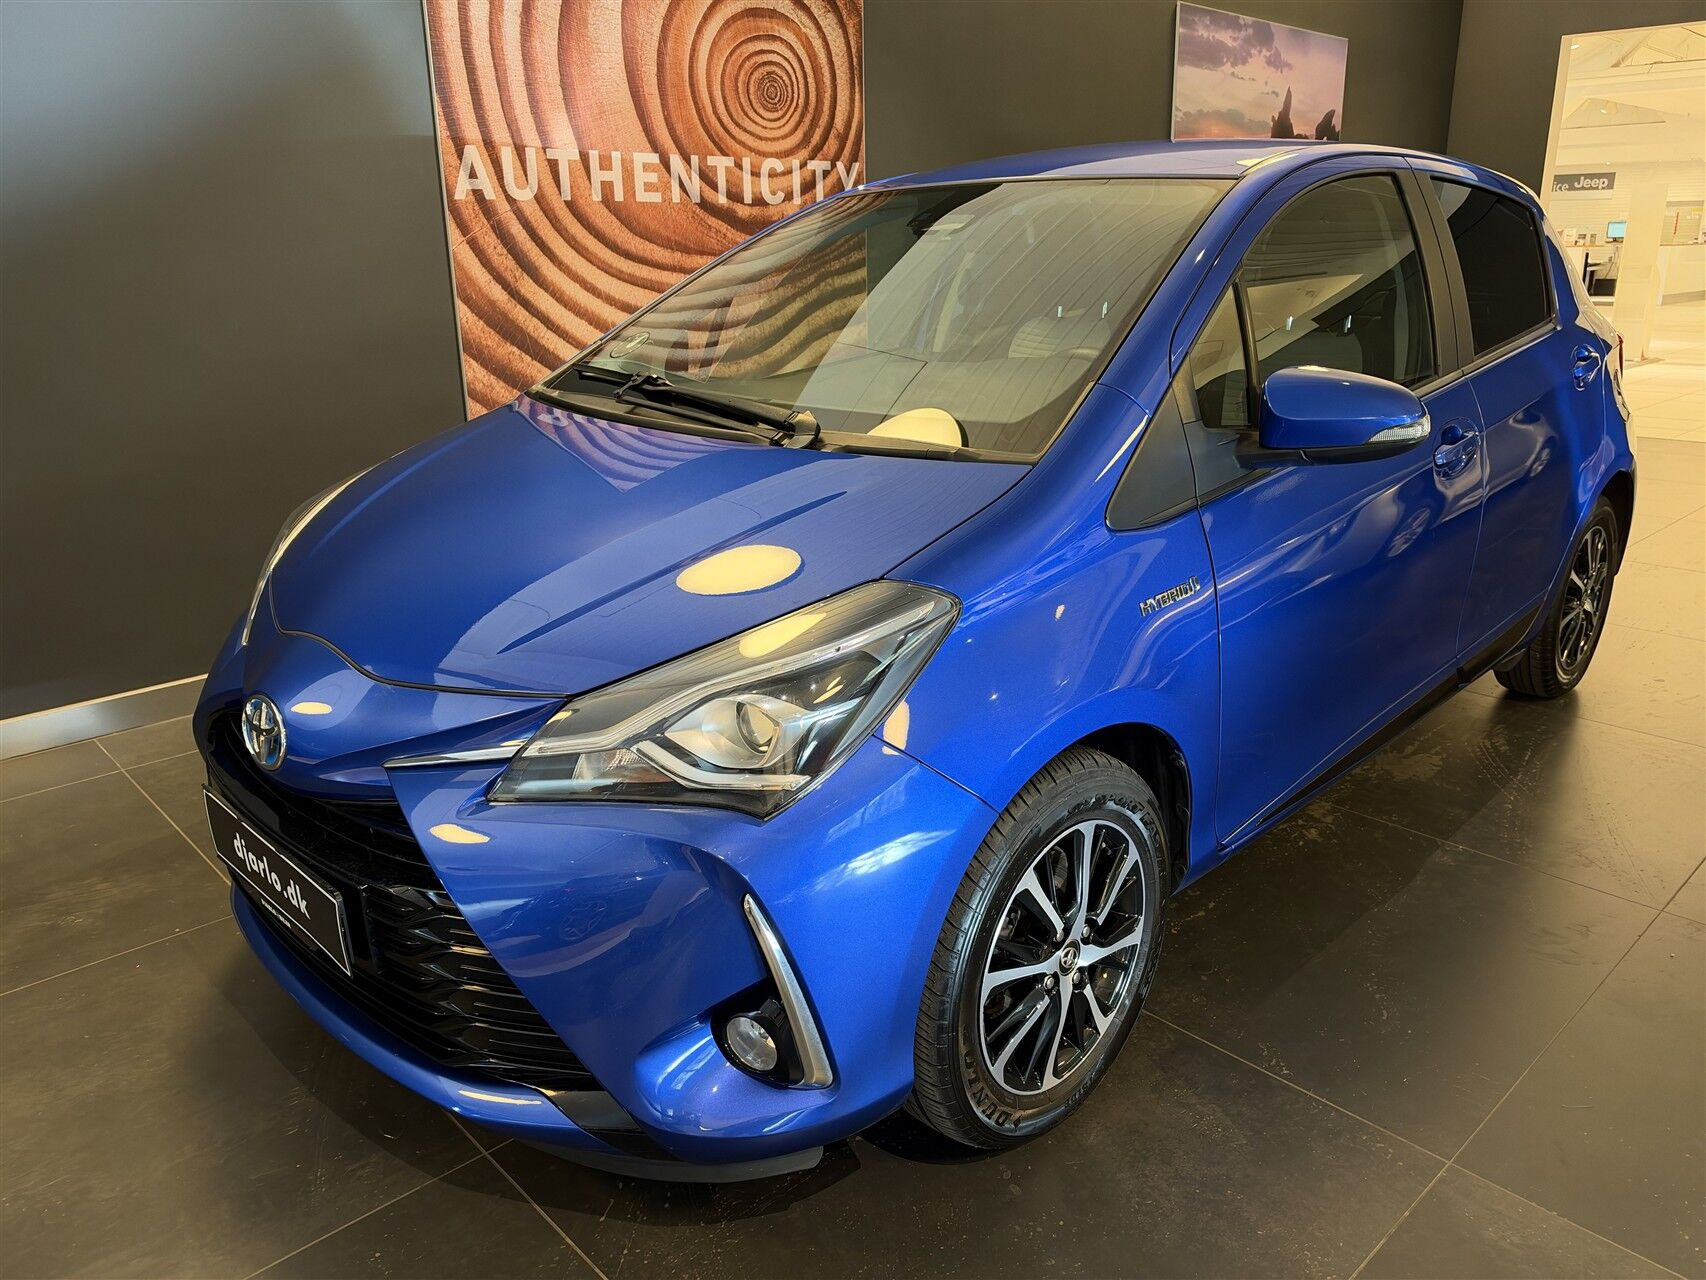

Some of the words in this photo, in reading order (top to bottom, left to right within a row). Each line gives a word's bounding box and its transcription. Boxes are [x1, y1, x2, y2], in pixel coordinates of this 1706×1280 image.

[454, 144, 860, 204] AUTHENTICITY
[1574, 176, 1609, 190] Jeep
[1139, 577, 1197, 617] HYBRID
[233, 832, 311, 920] djarlo.dk
